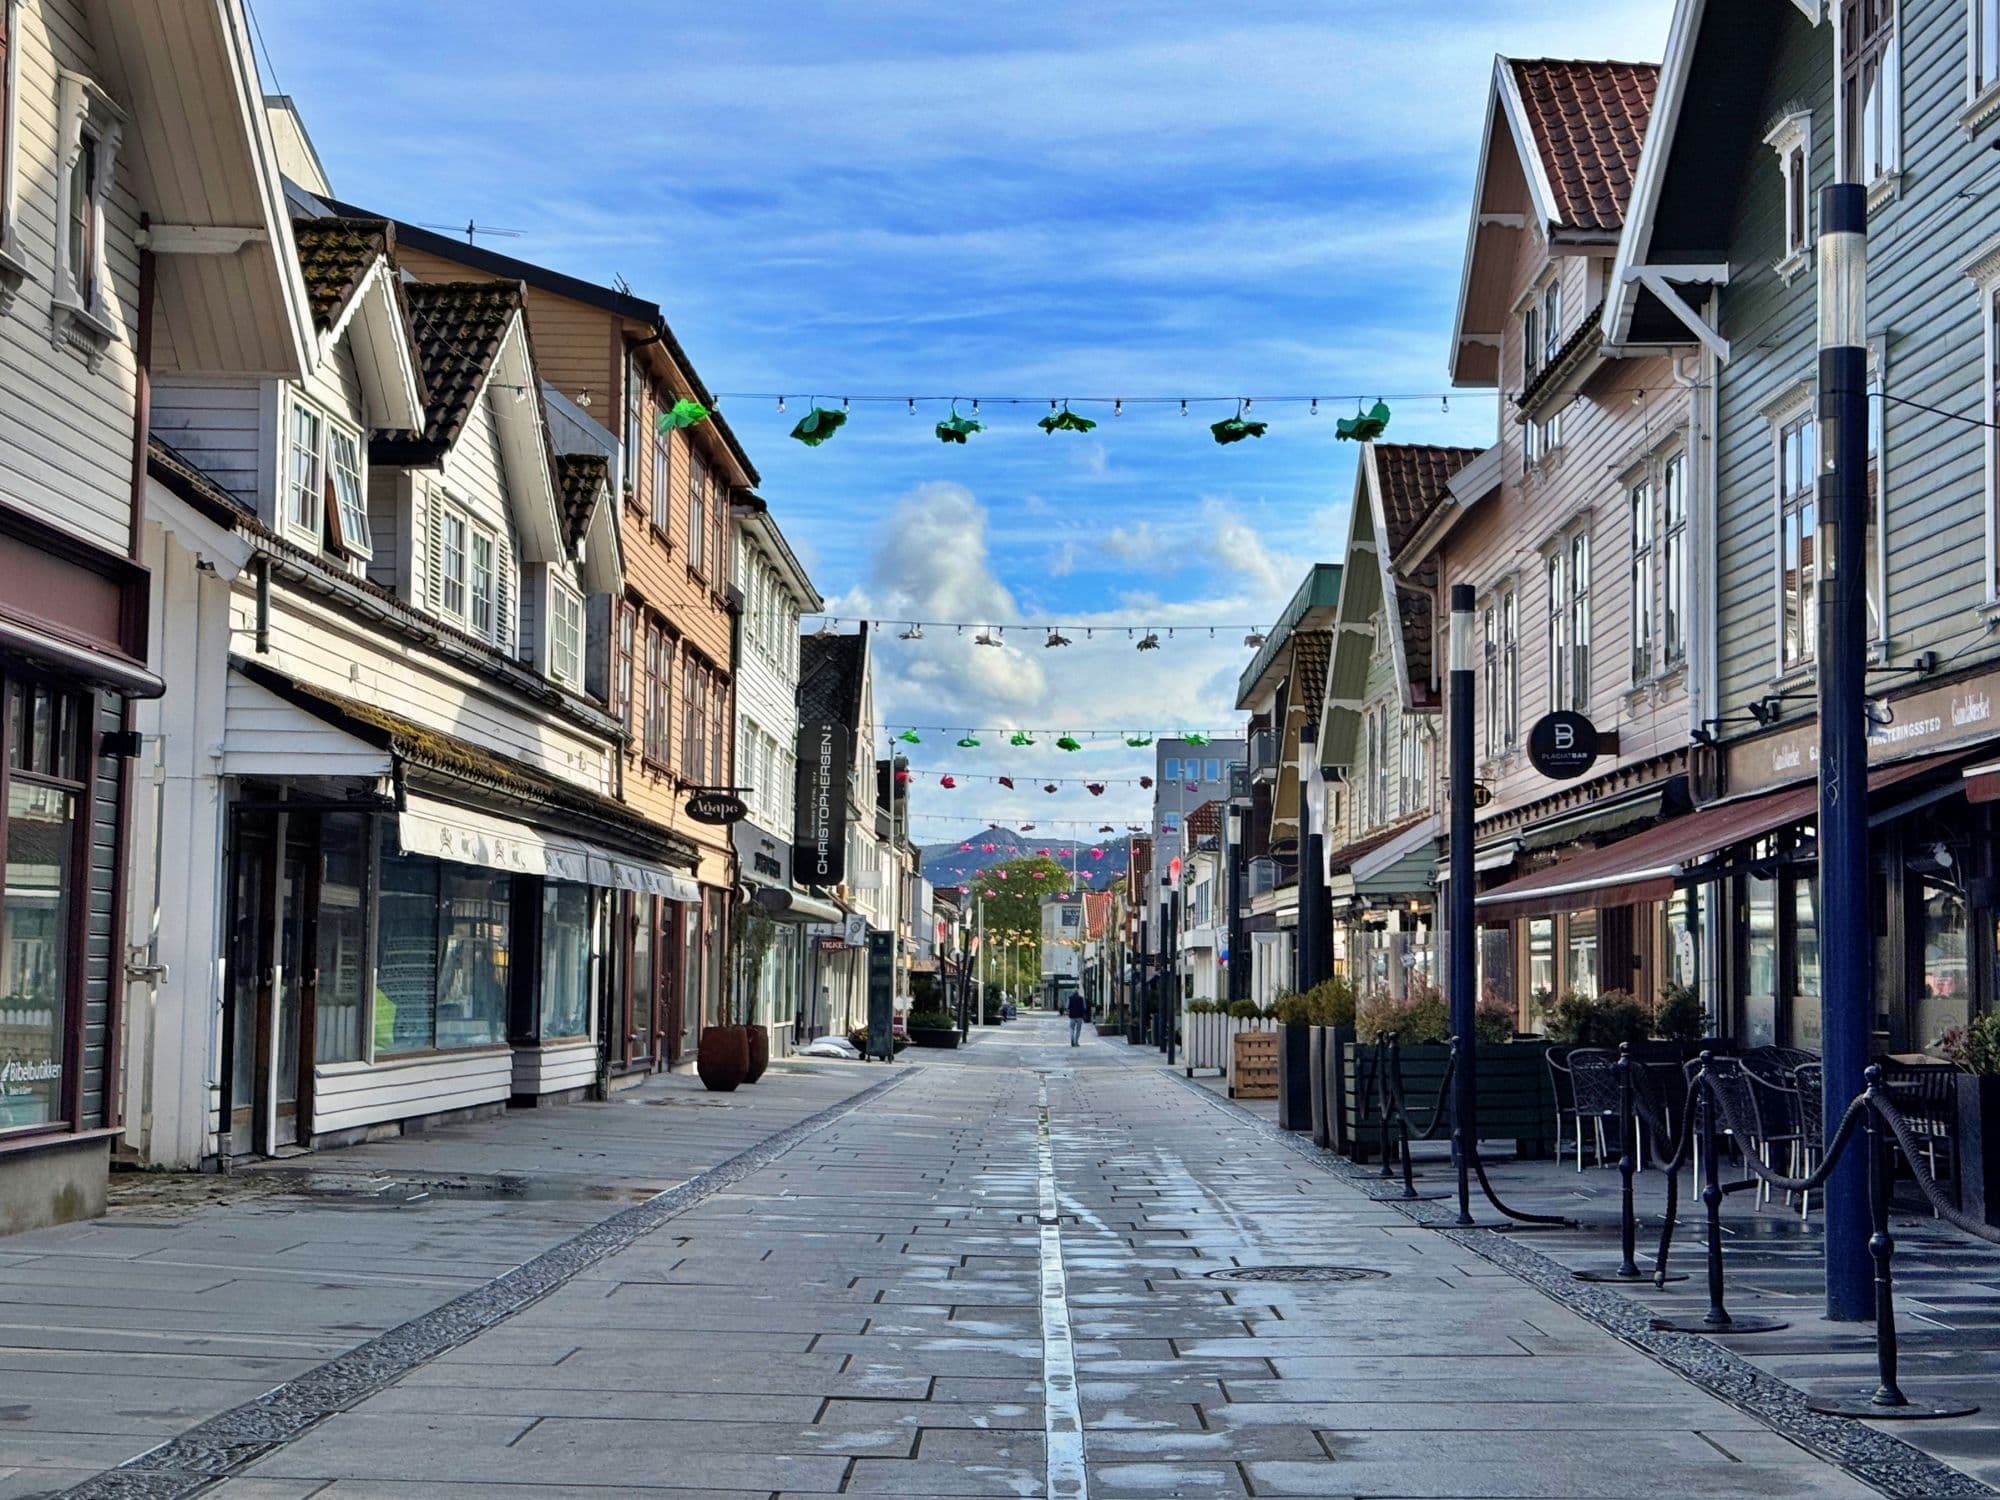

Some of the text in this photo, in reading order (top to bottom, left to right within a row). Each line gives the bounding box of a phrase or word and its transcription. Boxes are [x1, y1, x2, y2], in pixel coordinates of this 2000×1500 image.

[692, 800, 739, 820] Agape
[817, 733, 832, 875] CHRISTOPHERSEN
[10, 1058, 62, 1082] Bibelbutikken
